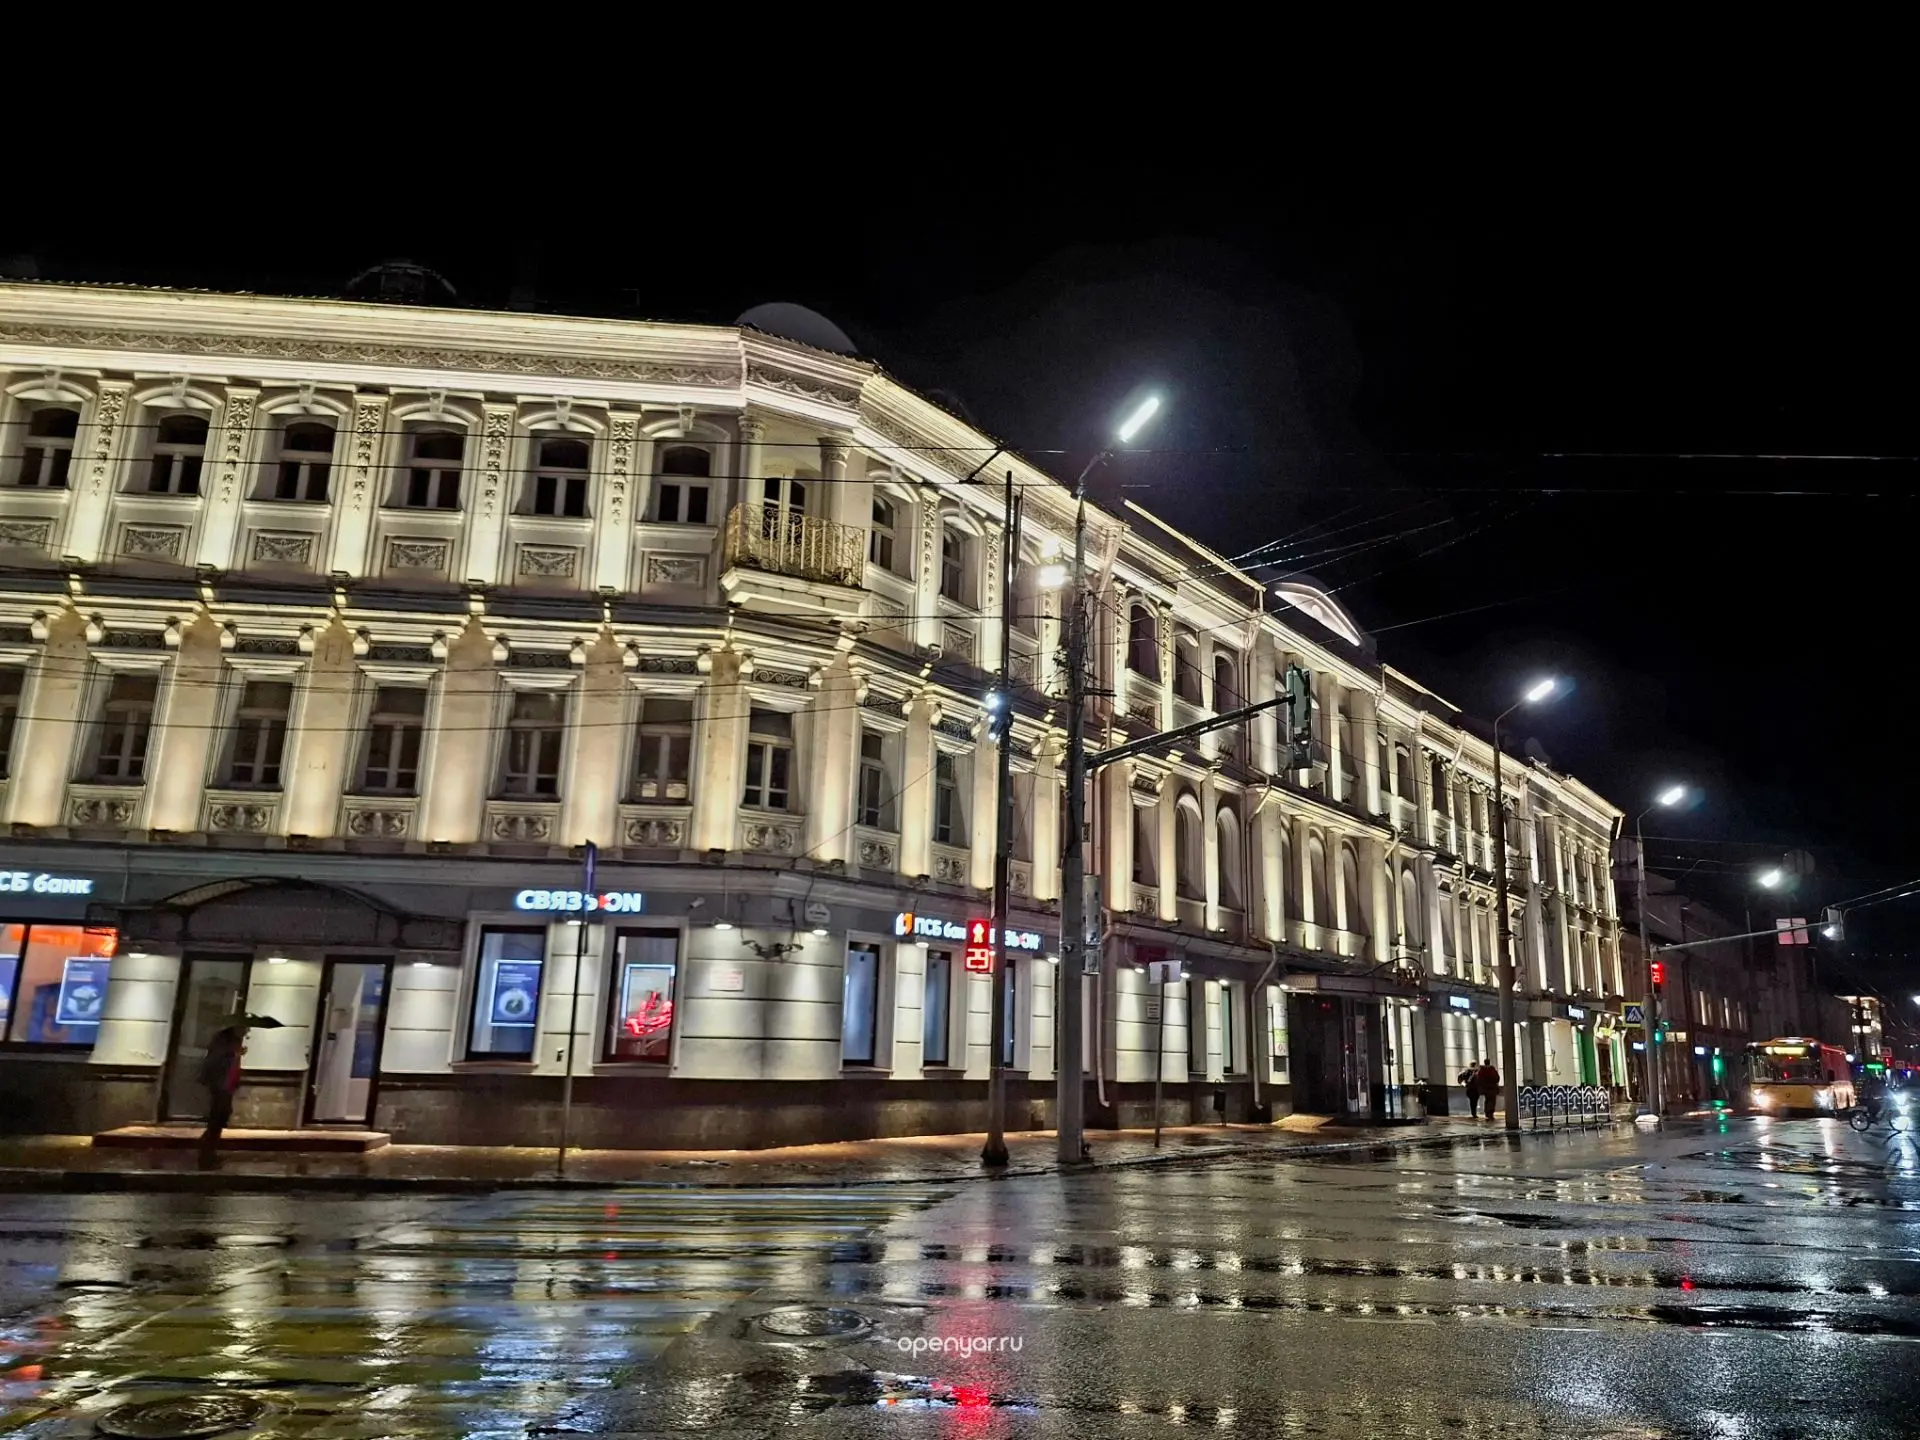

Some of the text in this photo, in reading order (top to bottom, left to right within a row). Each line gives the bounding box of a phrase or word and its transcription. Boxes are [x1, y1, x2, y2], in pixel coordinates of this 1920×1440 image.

[0, 871, 93, 894] СБ банк
[915, 917, 967, 939] ПСБ бан
